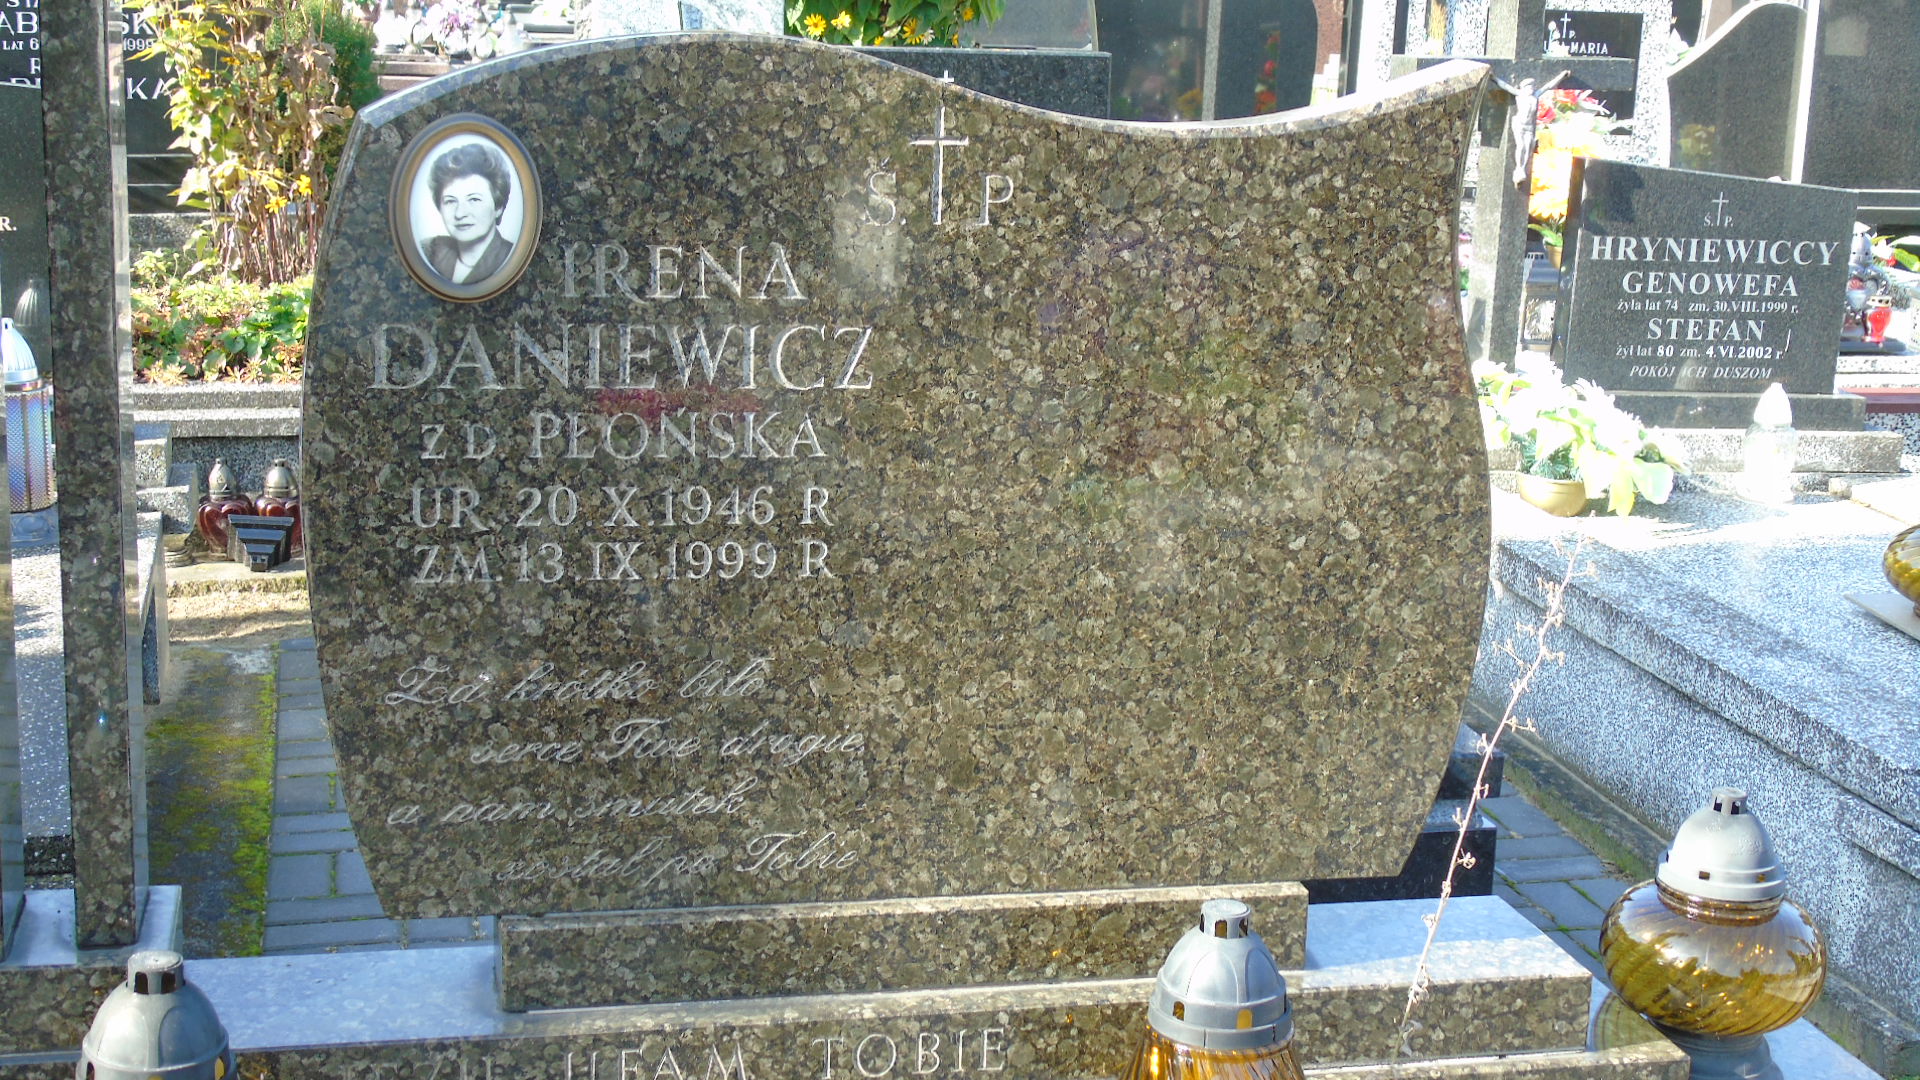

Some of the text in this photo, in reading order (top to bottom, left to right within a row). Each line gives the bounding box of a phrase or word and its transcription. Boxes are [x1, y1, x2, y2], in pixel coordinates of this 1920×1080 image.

[2, 40, 24, 50] LAT
[1569, 41, 1609, 55] MARIA
[1590, 235, 1839, 266] HRYNIEWICCY
[562, 242, 808, 304] IRENA
[1622, 271, 1798, 297] GENOWEFA
[1617, 299, 1641, 313] żyła
[1645, 299, 1661, 311] lat
[1665, 299, 1679, 311] 74
[1688, 302, 1709, 312] zm.
[1713, 300, 1787, 313] 30.VIII.1999
[1647, 317, 1765, 341] STEFAN
[367, 322, 874, 391] DANIEWICZ
[1615, 344, 1633, 358] żył
[1637, 345, 1652, 357] lat
[1656, 345, 1674, 357] 80
[1679, 348, 1701, 358] zm.
[1705, 346, 1773, 359] 4.VI.2002
[1629, 363, 1773, 379] POKÓJ ICH DUSZOM
[529, 407, 829, 460] PŁOŃSKA
[470, 739, 583, 764] serce
[591, 717, 701, 761] Twe
[387, 803, 421, 826] a
[574, 776, 758, 819] smutek
[641, 853, 716, 889] po
[734, 831, 858, 873] Tobie
[811, 1027, 1005, 1080] TOBIE
